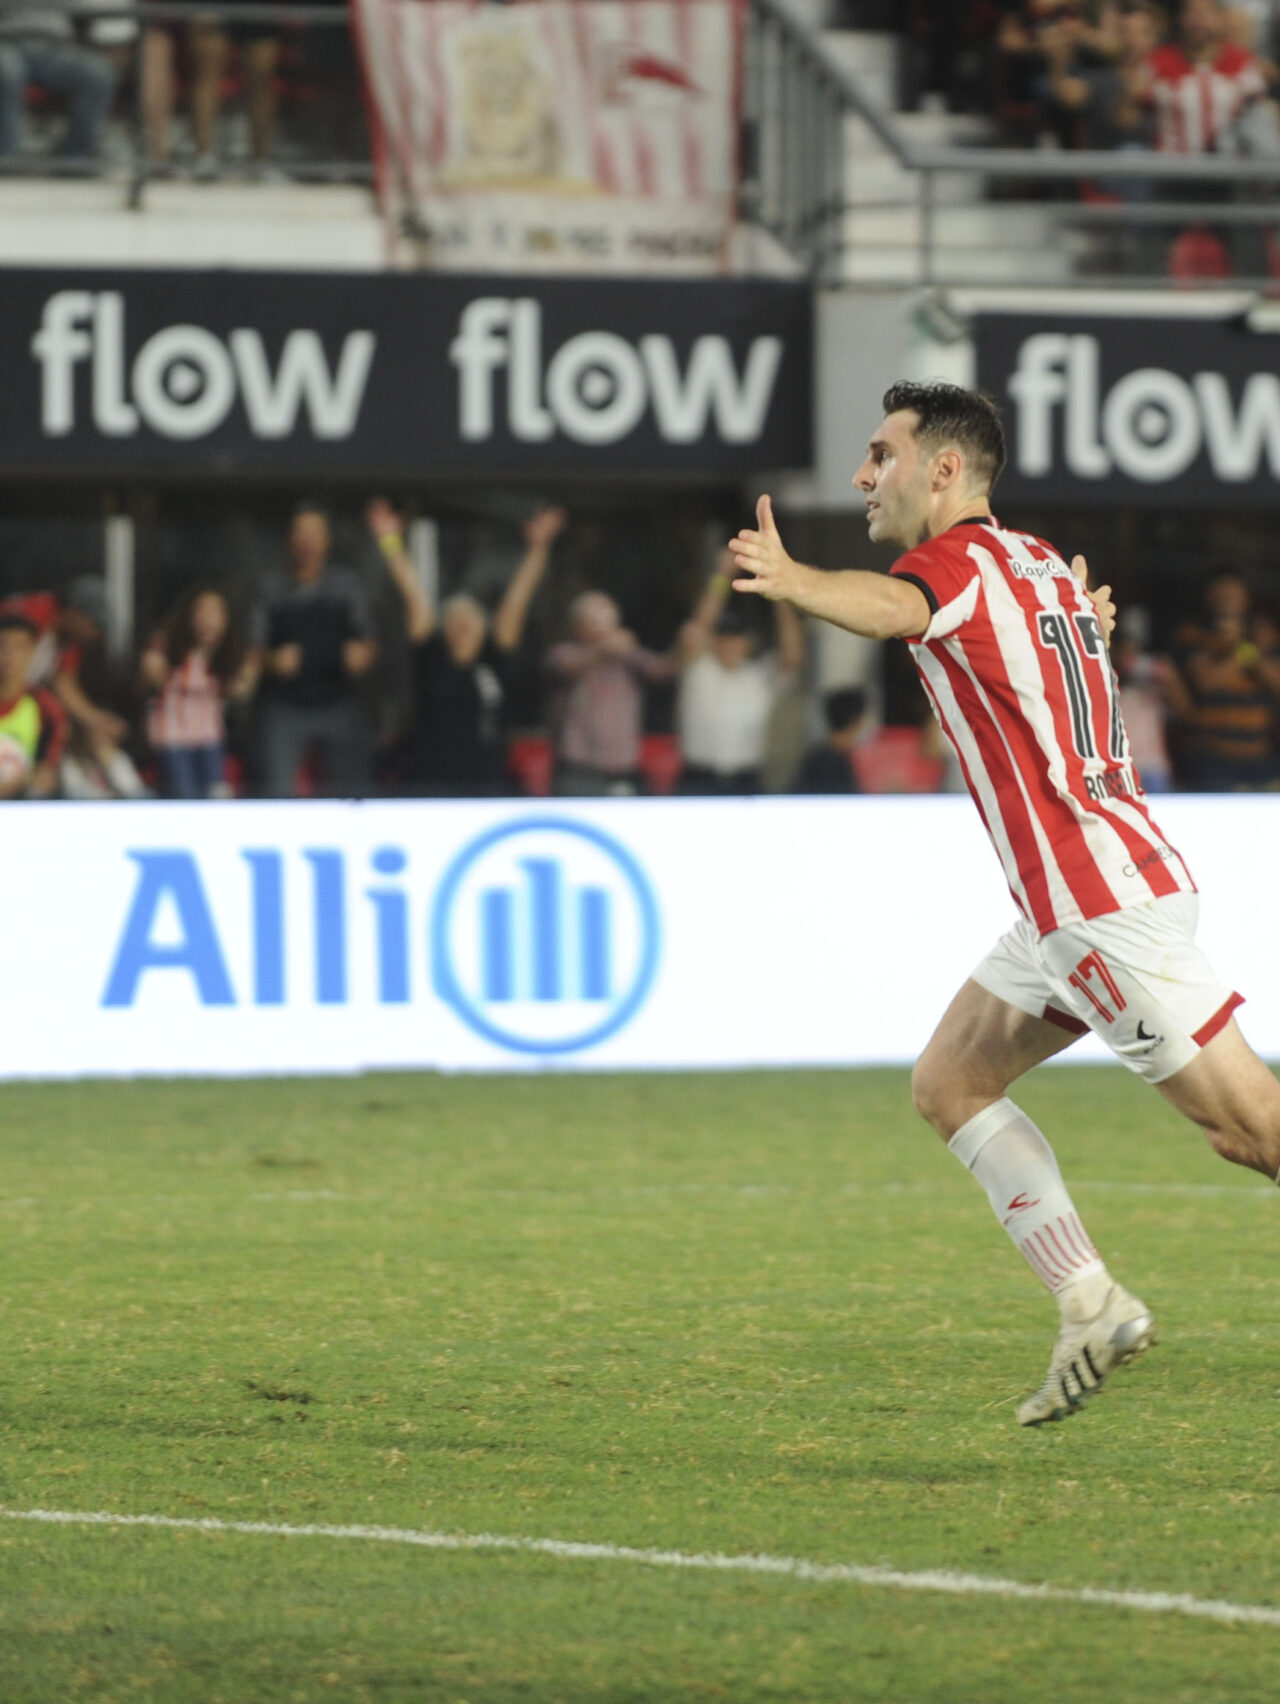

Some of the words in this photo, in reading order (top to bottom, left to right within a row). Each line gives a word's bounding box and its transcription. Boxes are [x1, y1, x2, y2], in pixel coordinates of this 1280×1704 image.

[33, 292, 376, 440] flow
[451, 298, 783, 445] flow
[1037, 612, 1126, 760] 17
[1067, 949, 1128, 1024] 17
